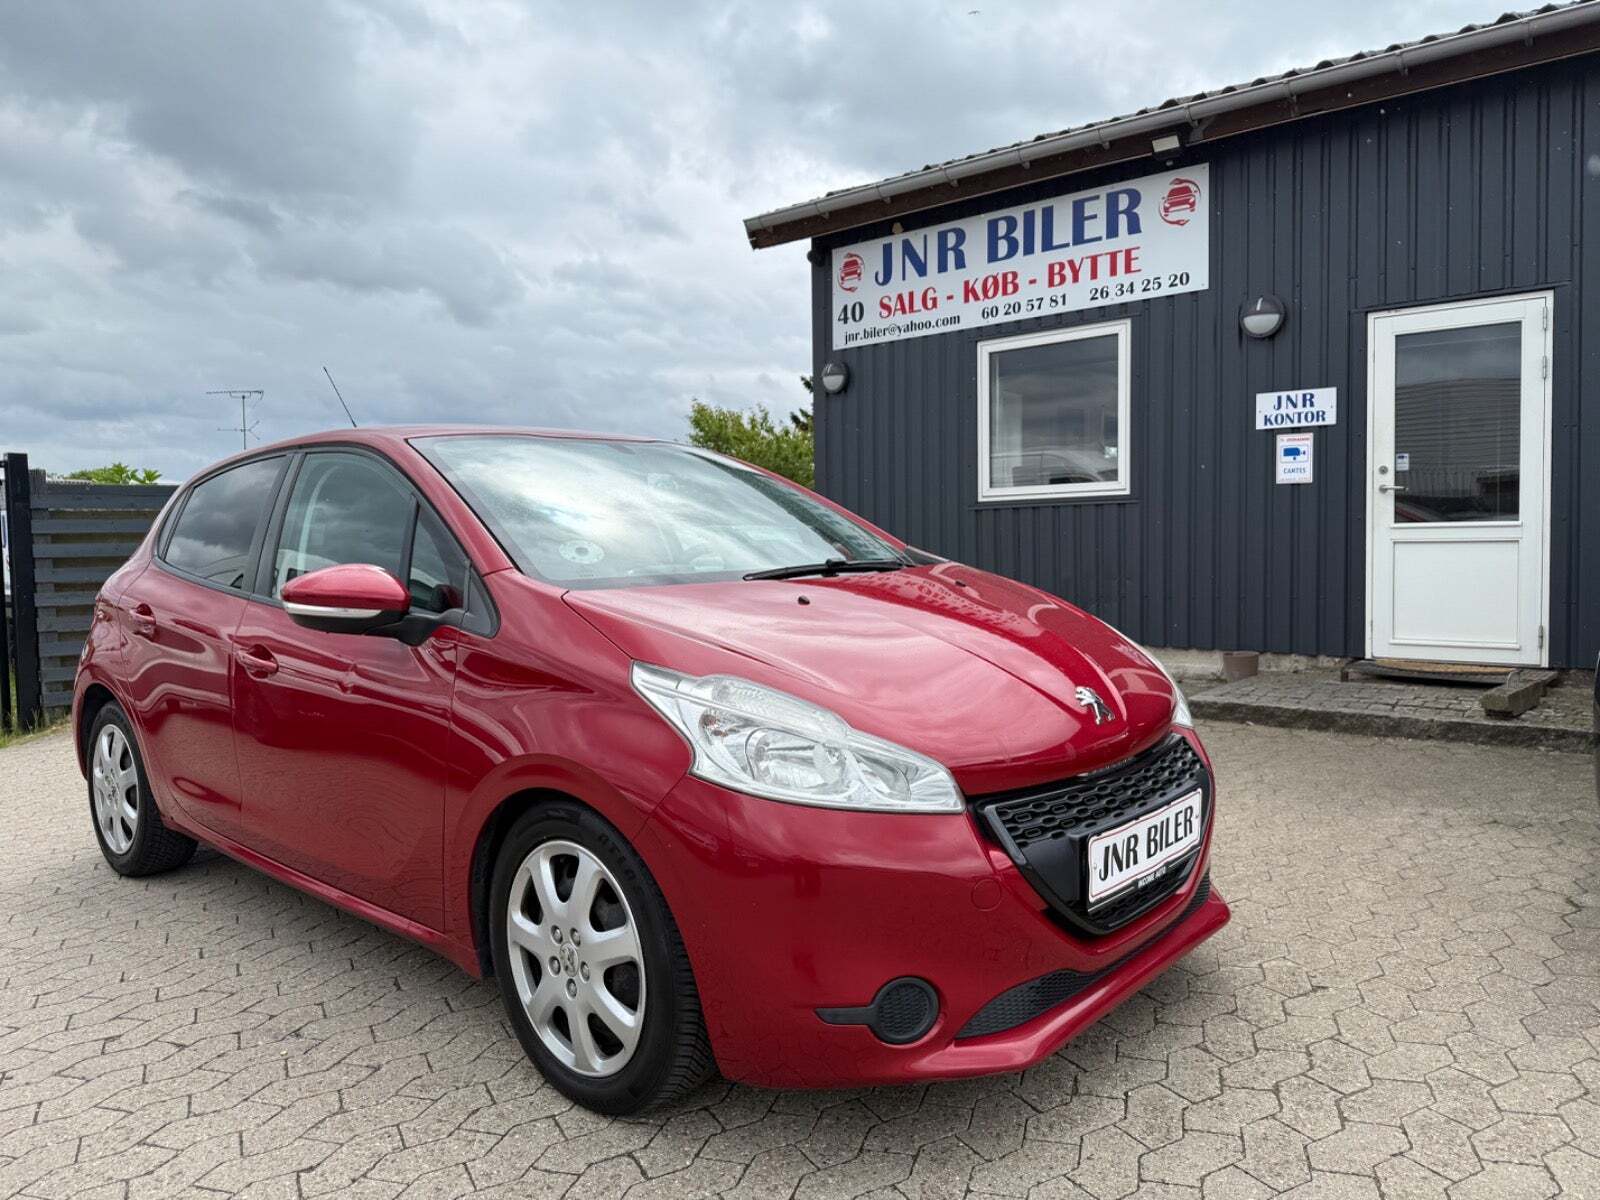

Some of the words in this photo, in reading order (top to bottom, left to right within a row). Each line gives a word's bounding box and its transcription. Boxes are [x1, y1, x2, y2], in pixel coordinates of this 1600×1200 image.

[875, 227, 967, 287] JNR
[986, 188, 1142, 264] BILER
[878, 286, 939, 319] SALG
[963, 270, 1020, 304] KØB
[1048, 246, 1143, 289] BYTTE
[1089, 285, 1109, 301] 26
[1115, 281, 1135, 297] 34
[1141, 276, 1162, 293] 25
[1168, 271, 1190, 288] 20
[837, 301, 865, 325] 40
[981, 306, 999, 319] 60
[1003, 301, 1021, 316] 20
[1025, 297, 1044, 312] 57
[1049, 293, 1067, 308] 81
[844, 315, 960, 344] jnr.biler@yahoo.com
[1274, 392, 1315, 410] JNR
[1263, 410, 1326, 426] KONTOR
[1098, 834, 1138, 881] JNR
[1146, 806, 1194, 859] BILER
